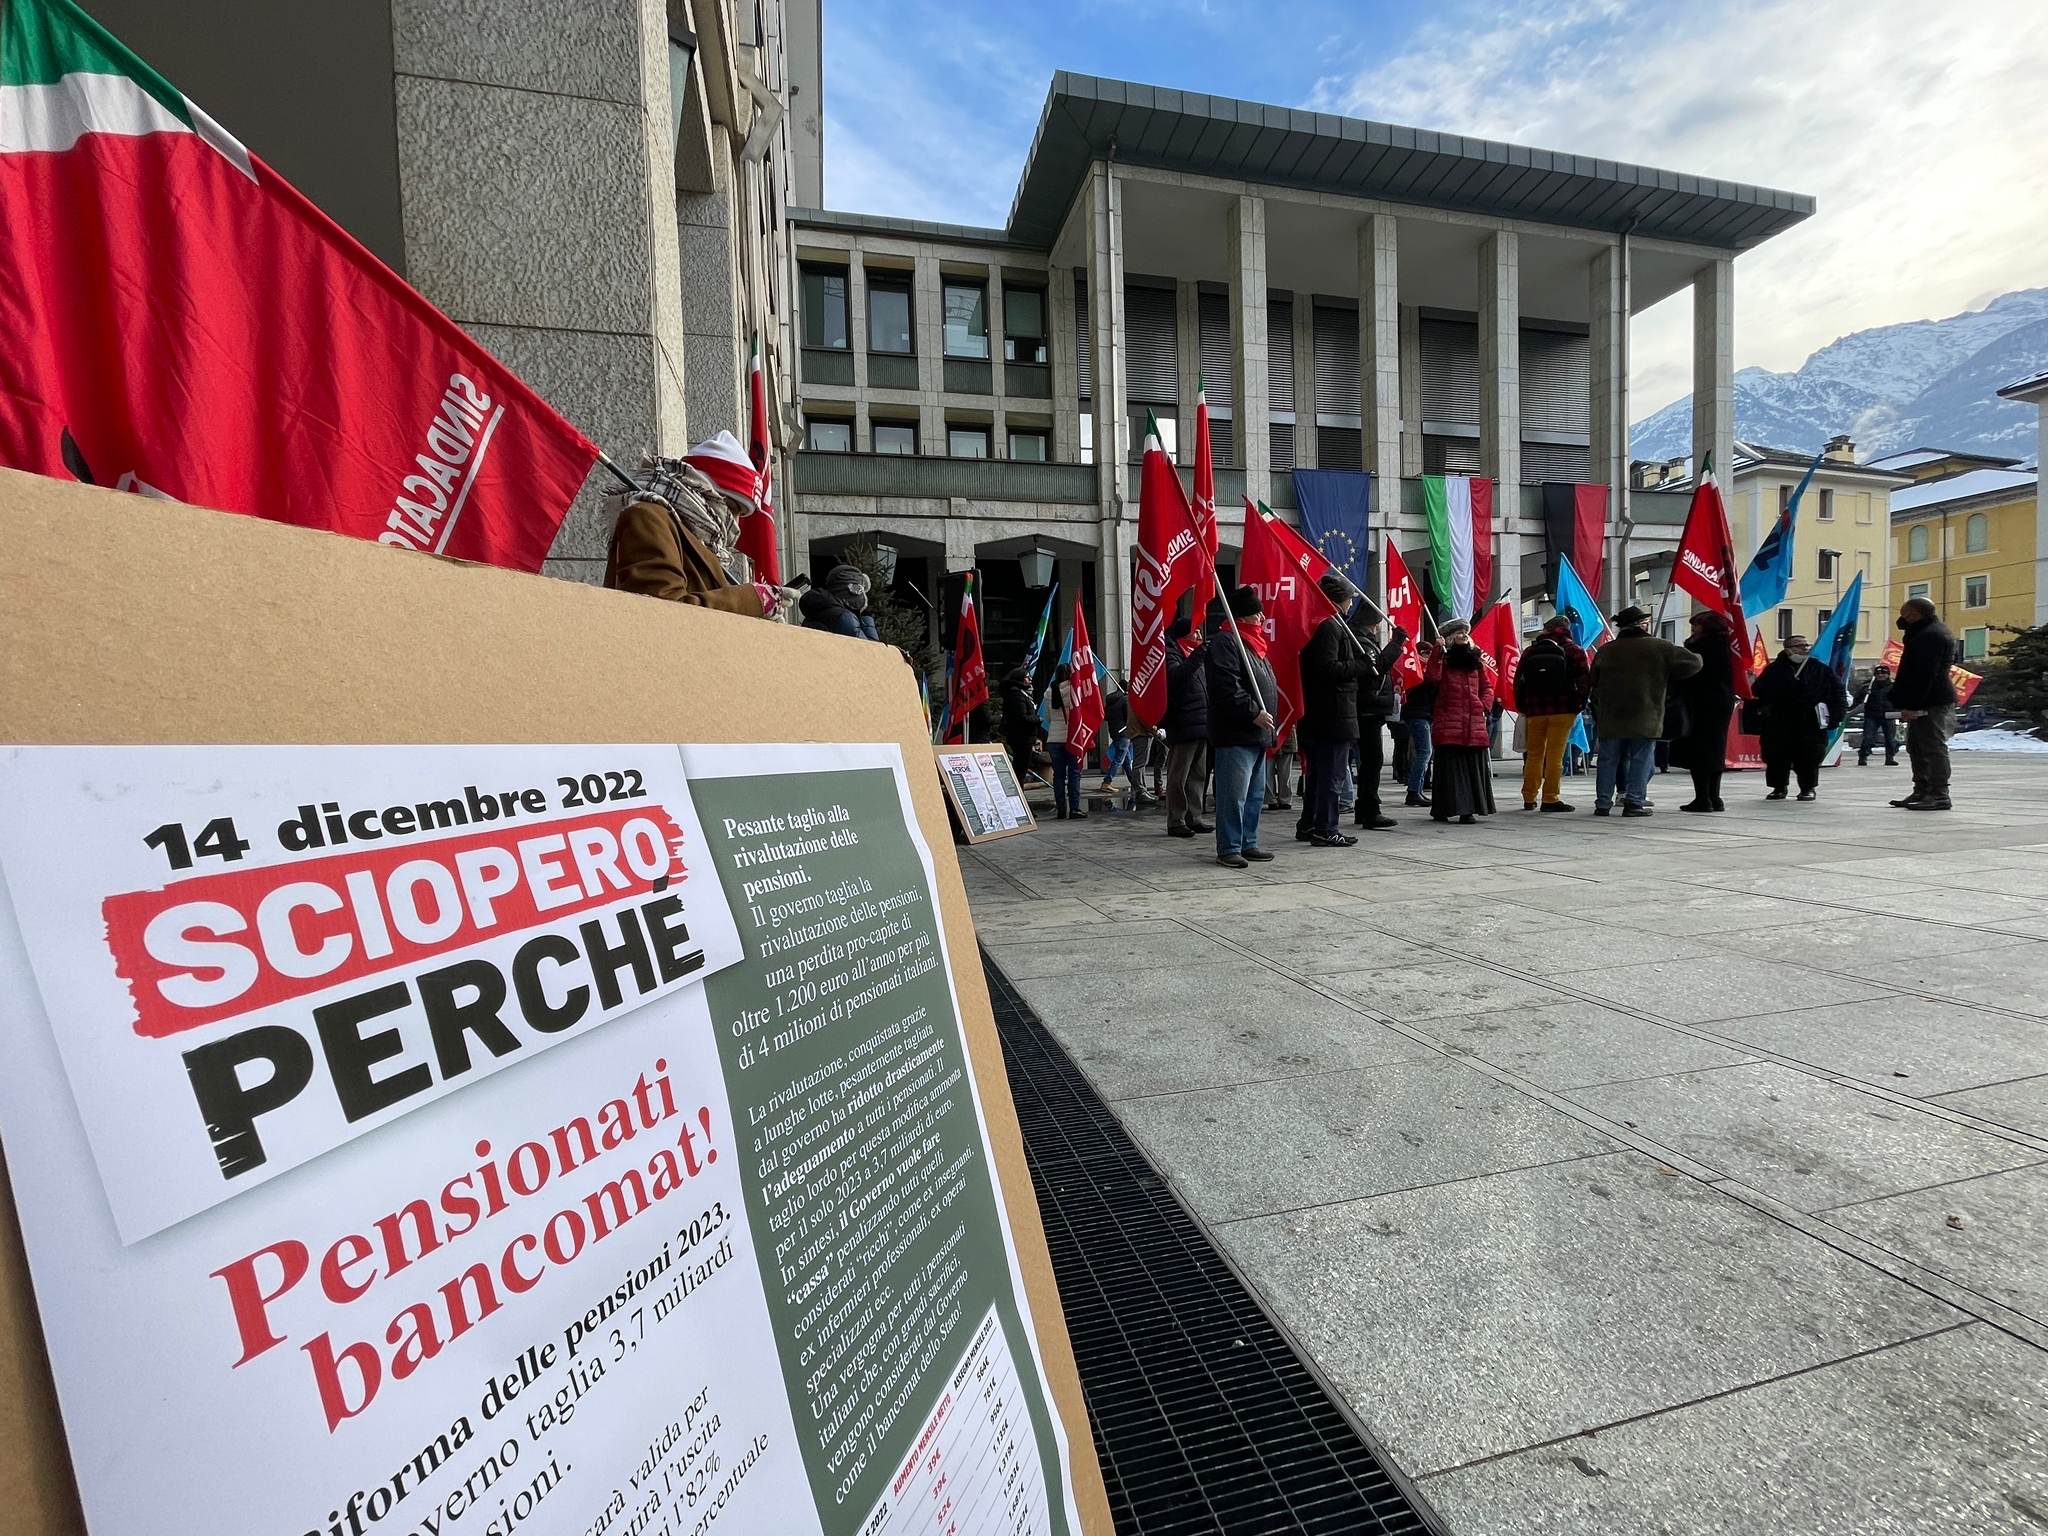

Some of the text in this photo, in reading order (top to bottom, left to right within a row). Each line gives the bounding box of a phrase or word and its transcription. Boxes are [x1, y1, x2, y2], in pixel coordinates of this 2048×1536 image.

[1683, 549, 1719, 583] SINDACA
[143, 769, 646, 872] 14 dicembre 2022
[723, 804, 850, 840] Pesante taglio alla
[733, 828, 859, 868] rivalutazione delle
[142, 817, 671, 1009] SCIOPERO
[742, 864, 812, 902] pensioni.
[751, 877, 872, 927] Il governo taglia la
[760, 886, 922, 958] rivalutazione delle pensioni,
[732, 931, 930, 1038] oltre 1.200 euro all’anno per più
[738, 952, 938, 1070] di 4 milioni di pensionati italiani.
[765, 913, 912, 988] una perdita pro-capite di
[180, 875, 705, 1180] PERCHÉ
[748, 1005, 927, 1127] La rivalutazione, conquistata grazie
[754, 1023, 934, 1153] a lunghe lotte, pesantemente tagliata
[758, 1037, 945, 1179] dal governo ha ridotto drasticamente
[762, 1058, 945, 1207] l’adeguamento a tutti i pensionati. Il
[769, 1068, 962, 1232] taglio lordo per questa modifica ammonta
[209, 1057, 679, 1369] Pensionati
[775, 1099, 955, 1265] per il solo 2023 a 3,7 miliardi di euro.
[780, 1132, 941, 1287] In sintesi, il Governo vuole fare
[787, 1150, 945, 1305] “cassa” penalizzando tutti quelli
[794, 1263, 856, 1340] considerati
[898, 1196, 921, 1229] come
[922, 1188, 934, 1203] ex
[934, 1144, 975, 1191] insegnanti,
[300, 1106, 719, 1434] bancomat!
[800, 1174, 967, 1367] ex infermieri professionali, ex operai
[811, 1221, 966, 1420] Una vergogna per tutti i pensionati
[303, 1203, 732, 1536] iforma delle pensioni 2023.
[526, 1237, 735, 1441] taglia 3,7 miliardi
[806, 1288, 895, 1395] specializzati ecc.
[818, 1254, 961, 1450] italiani che, con grandi sacrifici,
[826, 1270, 968, 1475] vengono considerati dal Governo
[954, 1356, 971, 1390] ASSEGNO
[970, 1331, 985, 1361] MENSILE
[629, 1422, 681, 1490] valida
[684, 1386, 708, 1434] per
[663, 1414, 722, 1496] l’uscita
[835, 1300, 964, 1505] come il bancomat dello Stato!
[894, 1393, 951, 1497] AUMENTO MENSILE NETTO
[928, 1447, 941, 1475] 39€
[871, 1502, 888, 1534] 2022
[933, 1472, 946, 1499] 39€
[938, 1496, 951, 1524] 52€
